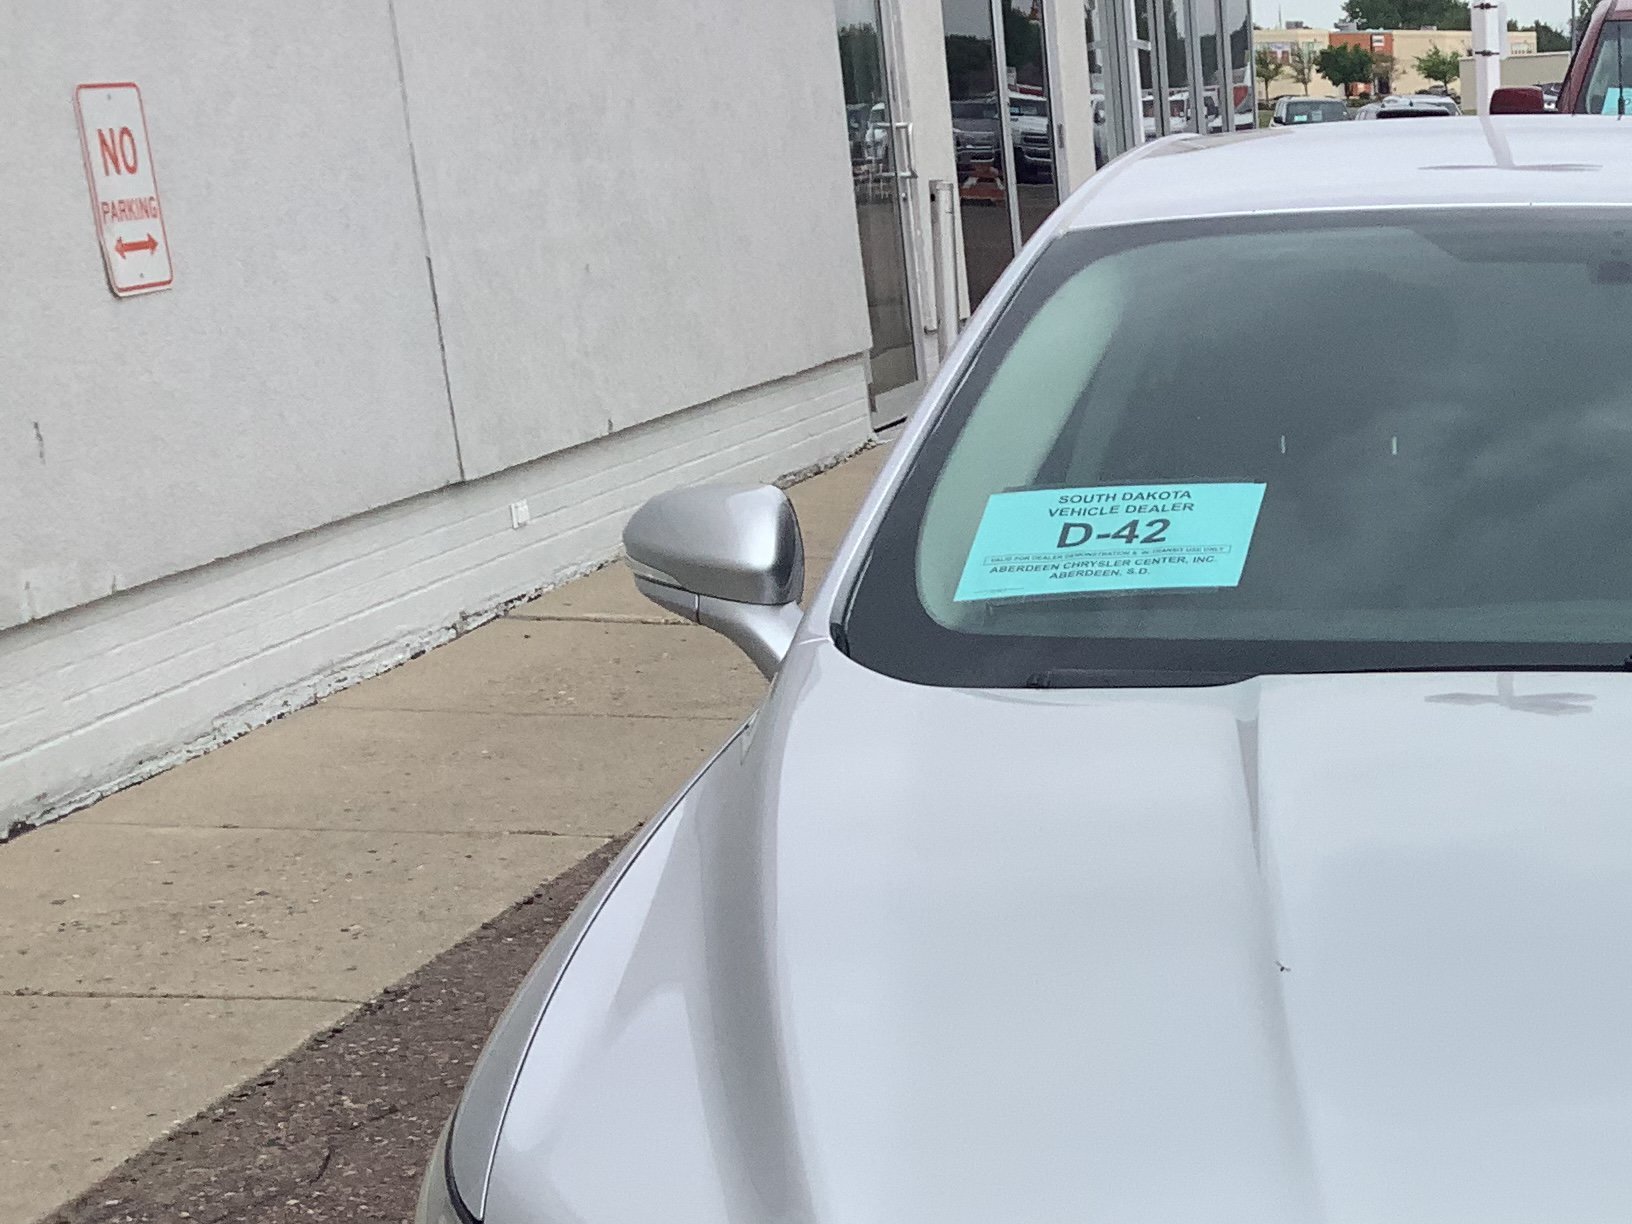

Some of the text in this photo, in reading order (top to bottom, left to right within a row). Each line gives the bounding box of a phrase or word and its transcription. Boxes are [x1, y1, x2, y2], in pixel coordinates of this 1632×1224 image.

[97, 126, 138, 177] NO
[101, 196, 158, 225] PARKING
[1058, 490, 1191, 504] SOUTH DAKOTA
[1049, 502, 1195, 517] VEHICLE DEALER
[1056, 518, 1171, 549] D-42
[989, 563, 1060, 574] ABERDEEN
[1063, 559, 1131, 570] CHRYSLER
[1127, 567, 1150, 575] S.D.
